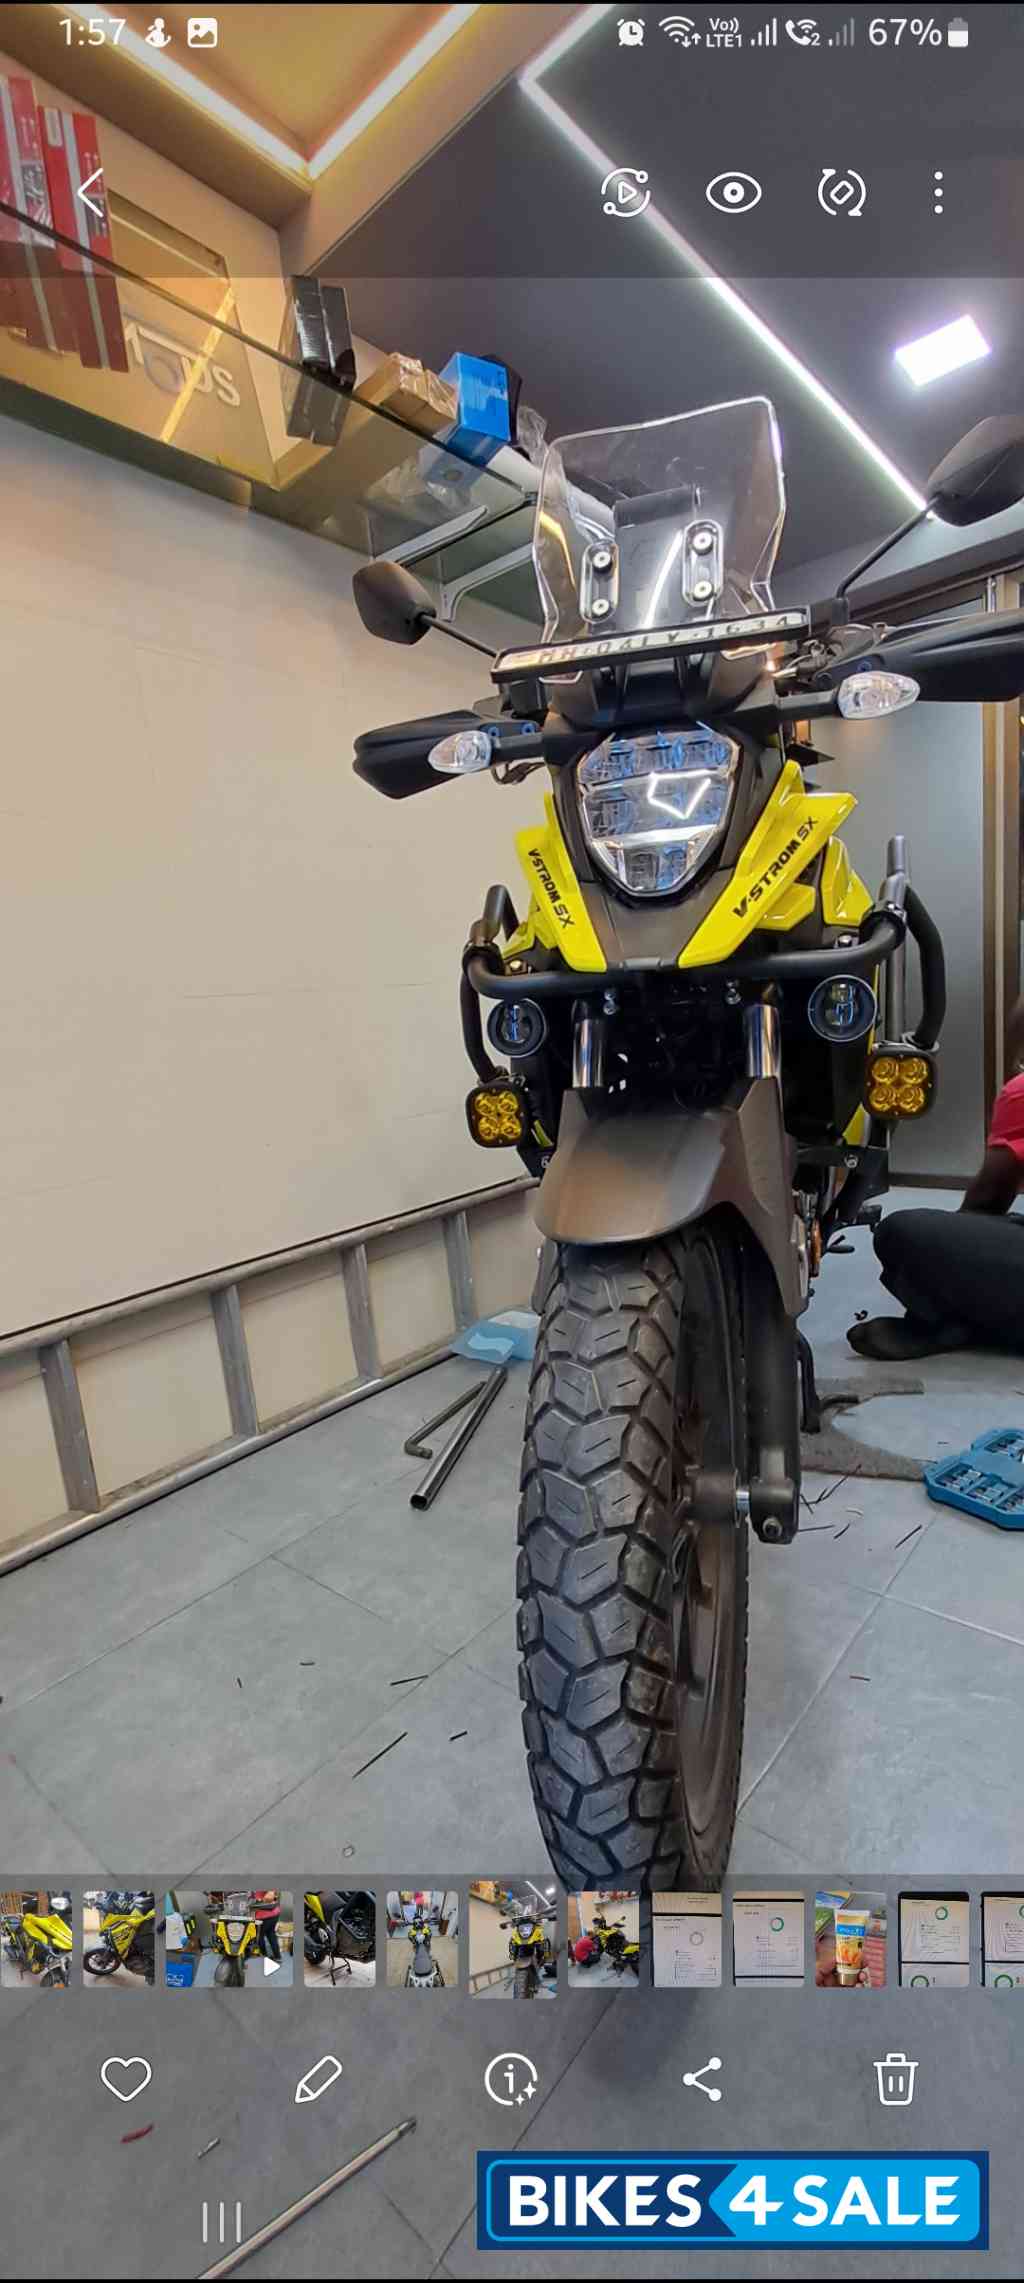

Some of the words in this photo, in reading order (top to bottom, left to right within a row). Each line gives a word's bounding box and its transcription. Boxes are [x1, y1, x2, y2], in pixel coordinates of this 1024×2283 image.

[732, 838, 802, 918] V-STROM
[797, 815, 818, 842] SX
[552, 904, 575, 929] SX
